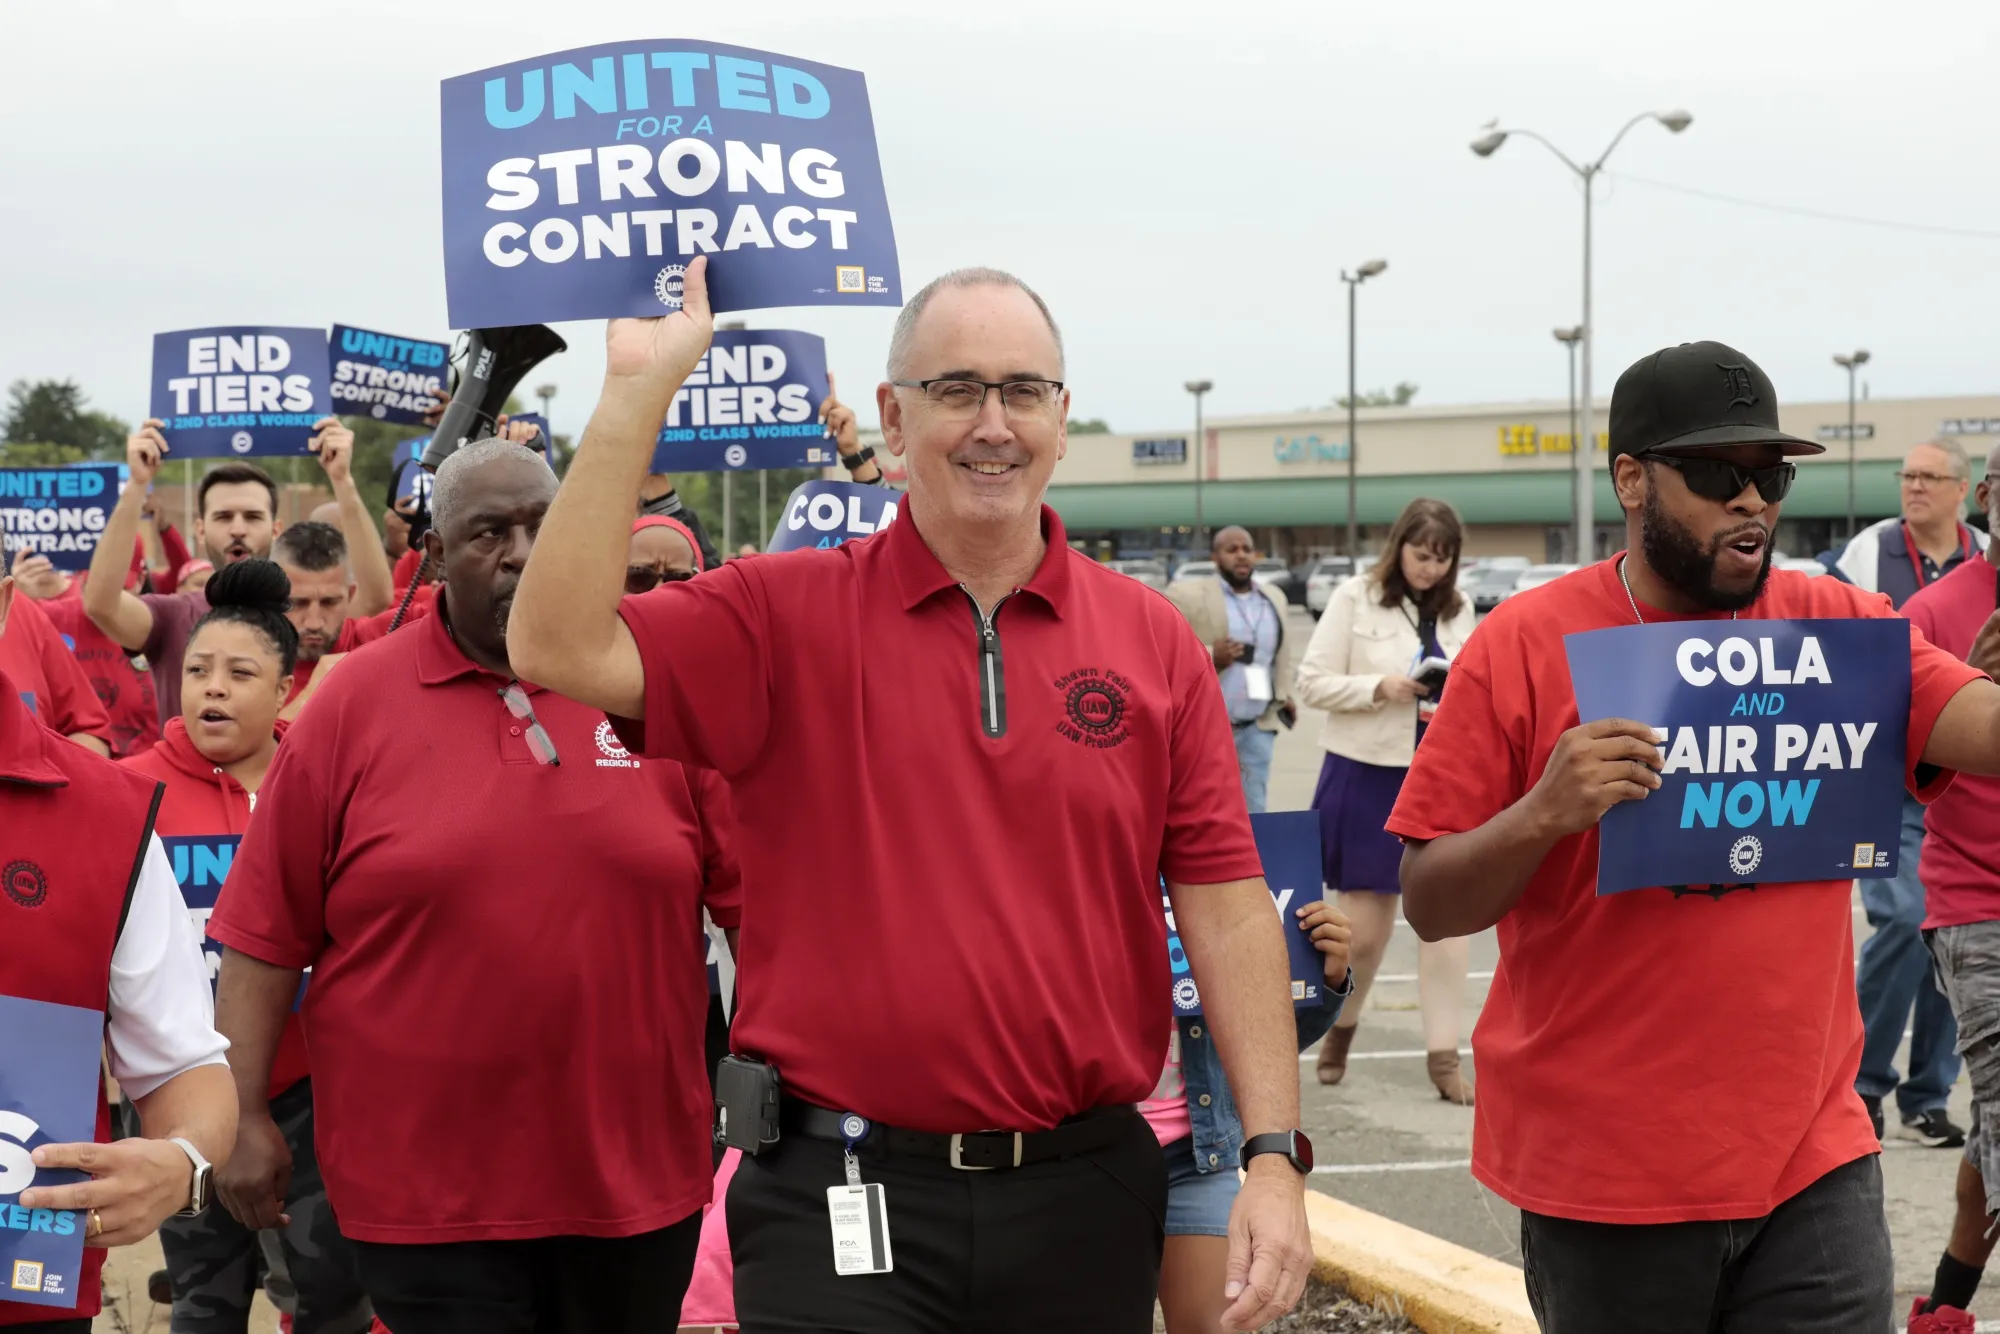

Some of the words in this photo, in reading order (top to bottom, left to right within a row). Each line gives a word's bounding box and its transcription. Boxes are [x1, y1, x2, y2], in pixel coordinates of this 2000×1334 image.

[484, 52, 831, 129] UNITED
[616, 117, 683, 140] FOR
[691, 115, 714, 135] A
[485, 138, 845, 211] STRONG
[483, 205, 857, 268] CONTRACT
[188, 335, 291, 375] END
[341, 328, 445, 368] UNITED
[473, 346, 492, 380] PYLE
[334, 360, 441, 396] STRONG
[168, 374, 314, 414] TIERS
[666, 384, 812, 427] TIERS
[174, 416, 204, 430] 2ND
[207, 414, 256, 428] CLASS
[664, 428, 696, 442] 2ND
[699, 426, 750, 441] CLASS
[2, 532, 103, 552] ONTRAC
[1676, 636, 1832, 687] COLA
[1054, 668, 1098, 691] Shawn
[1105, 669, 1130, 693] Fain
[1081, 701, 1110, 714] UAW
[1730, 693, 1785, 716] AND
[605, 734, 620, 743] UA
[1055, 720, 1083, 743] UAW
[1084, 726, 1131, 749] President
[1774, 722, 1878, 772] PAY
[595, 759, 631, 767] REGION
[1680, 779, 1821, 829] NOW
[1738, 850, 1754, 860] UAW
[43, 1286, 65, 1295] FIGHT
[44, 1273, 62, 1282] JOIN
